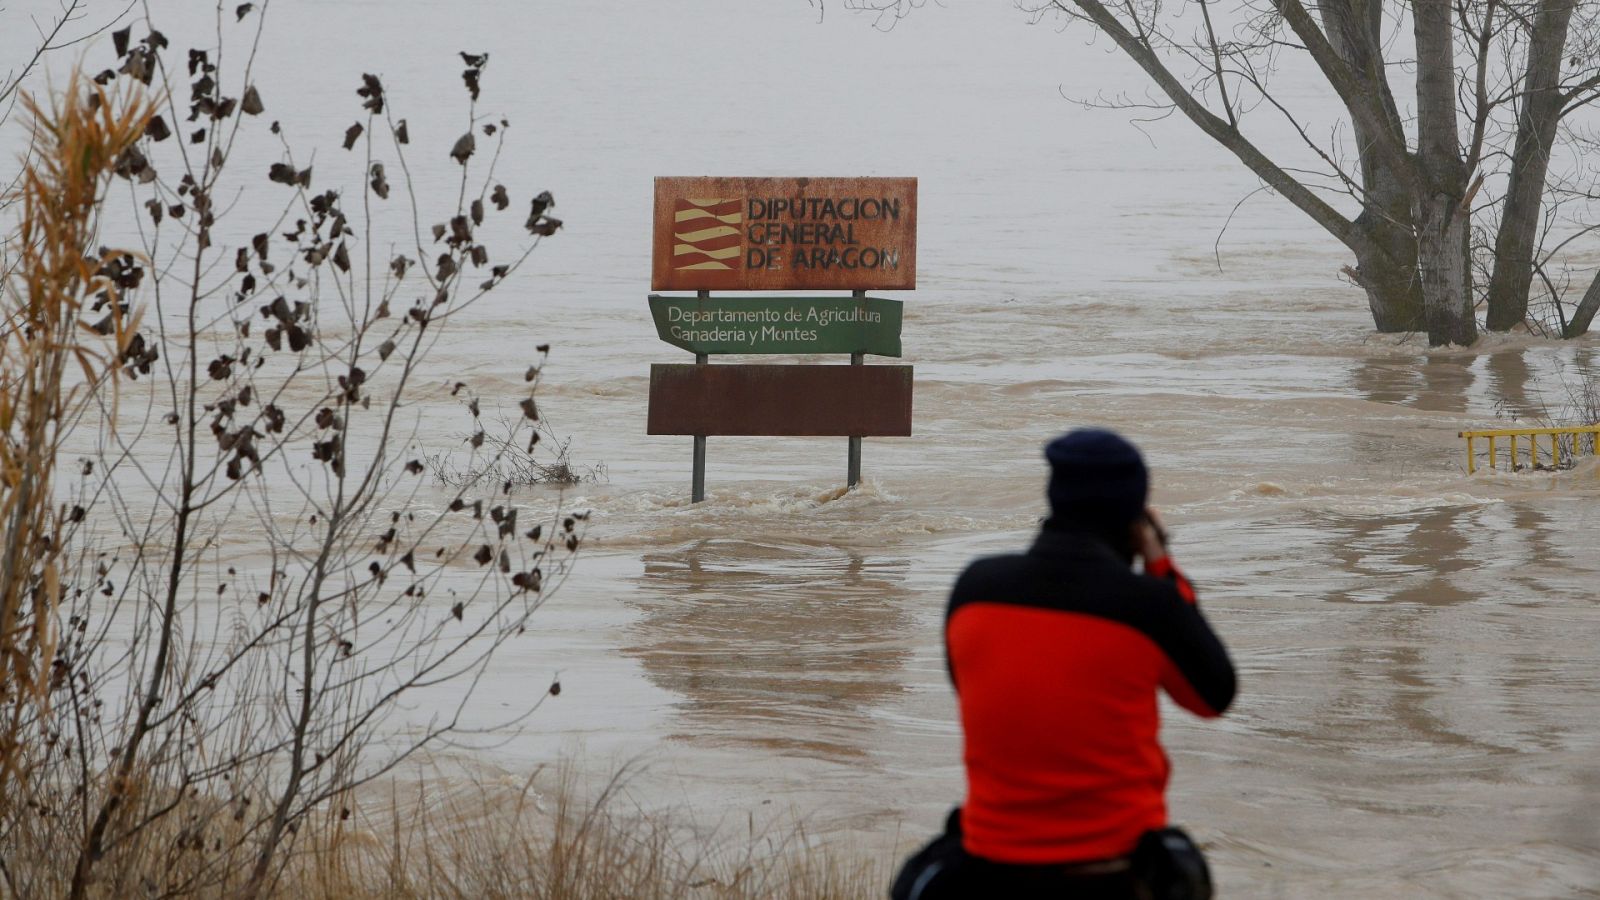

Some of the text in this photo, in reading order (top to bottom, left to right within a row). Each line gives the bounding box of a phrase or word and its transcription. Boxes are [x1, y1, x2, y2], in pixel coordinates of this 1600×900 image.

[747, 198, 899, 220] DIPUTACION
[747, 223, 859, 245] GENERAL
[746, 247, 898, 270] DE ARAGON
[668, 306, 881, 326] Departamento de Agricultura
[749, 329, 758, 345] y
[761, 326, 817, 341] Montes
